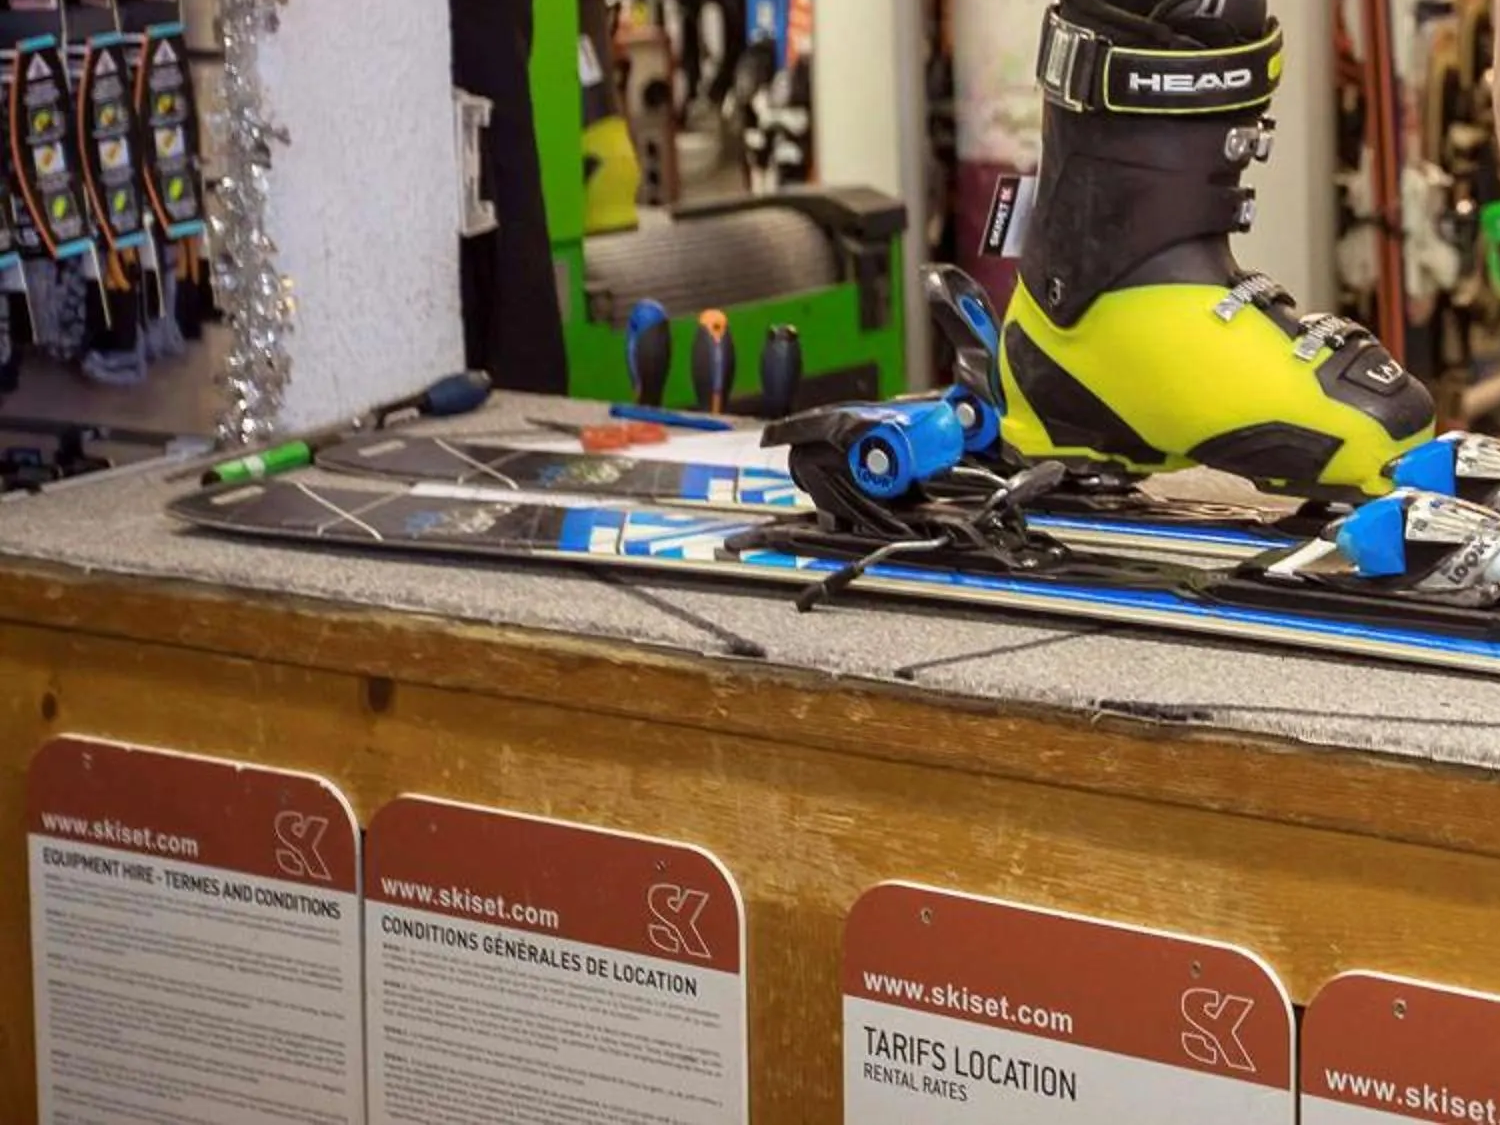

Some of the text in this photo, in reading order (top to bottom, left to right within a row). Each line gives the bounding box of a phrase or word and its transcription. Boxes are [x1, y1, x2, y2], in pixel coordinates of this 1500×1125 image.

[1129, 68, 1251, 92] HEAD
[1448, 541, 1491, 584] LOOK
[42, 812, 198, 856] www.skiset.com
[43, 847, 120, 878] EQUIPMENT
[122, 861, 154, 885] HIRE
[164, 869, 219, 897] TERMES
[223, 884, 252, 903] AND
[255, 888, 340, 919] CONDITIONS
[381, 877, 559, 929] www.skiset.com
[381, 915, 697, 996] CONDITIONS GÉNÉRALES DE LOCATION
[863, 971, 1073, 1033] www.skiset.com
[864, 1026, 1077, 1101] TARIFS LOCATION
[864, 1063, 967, 1103] RENTAL RATES
